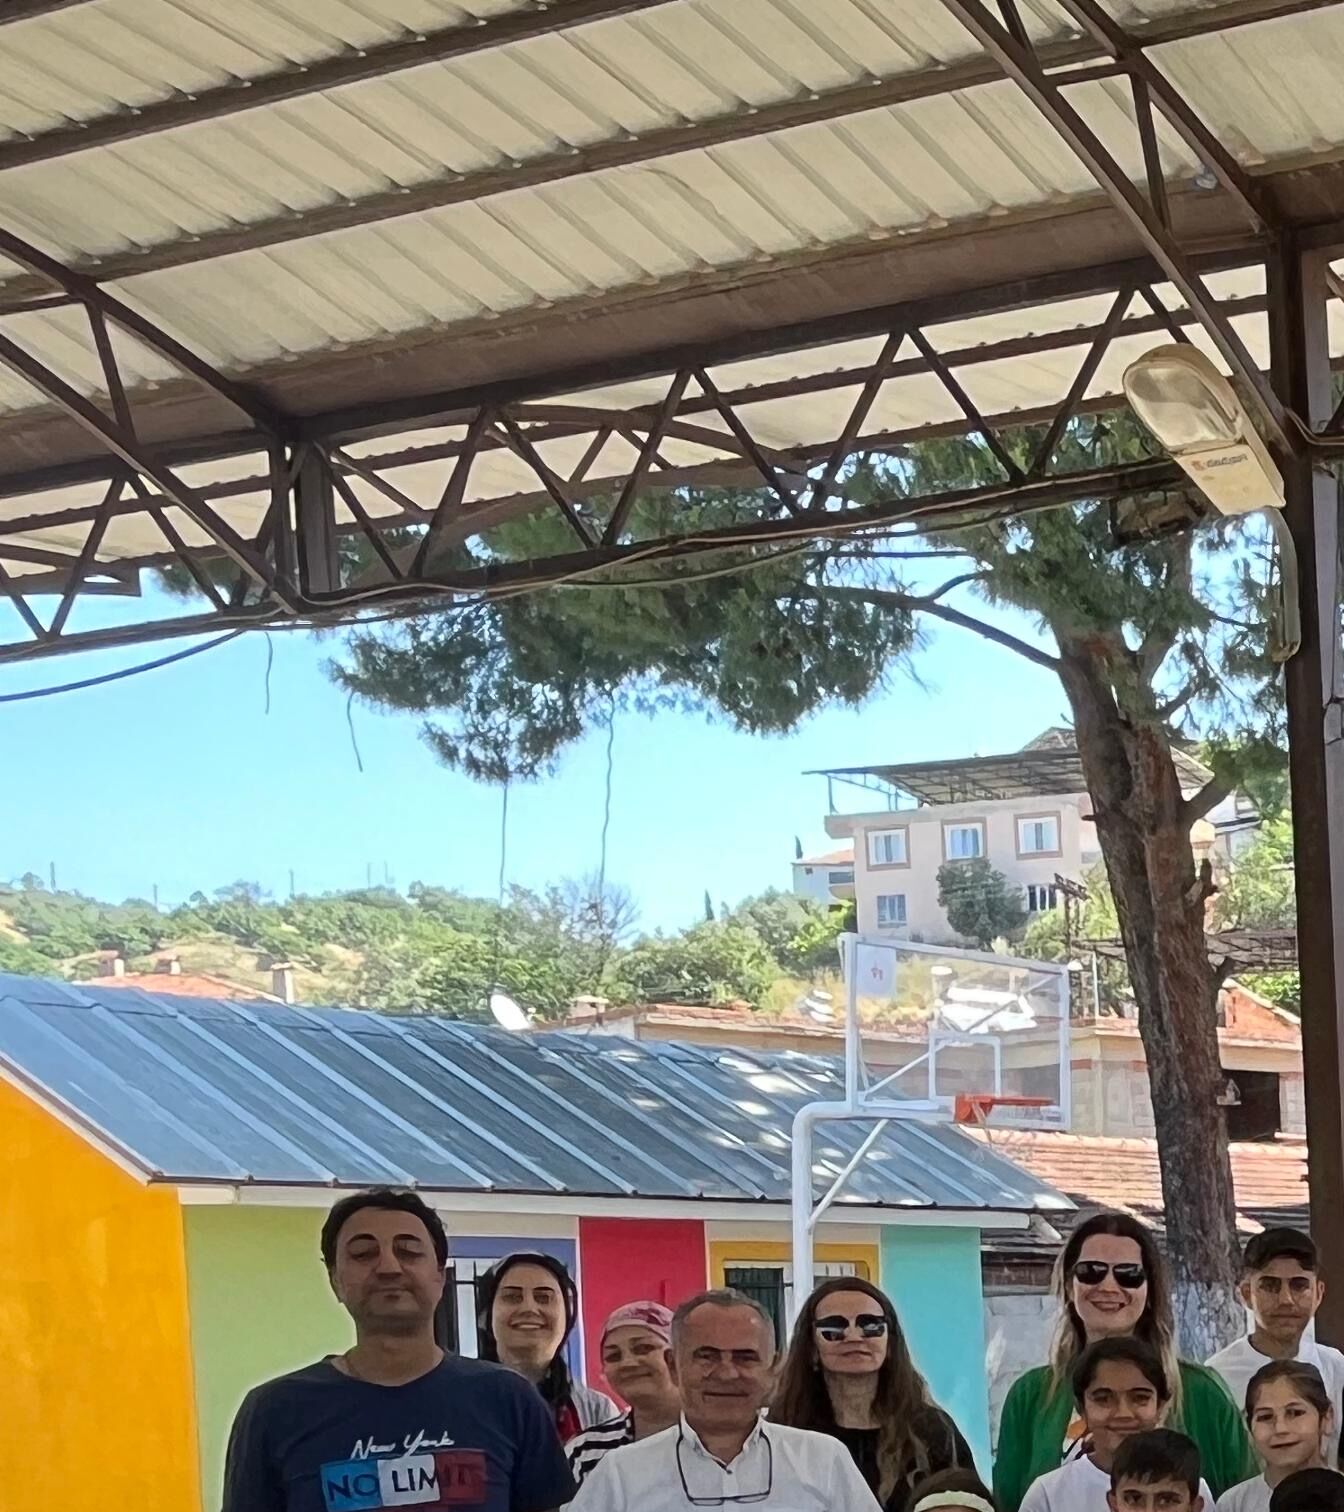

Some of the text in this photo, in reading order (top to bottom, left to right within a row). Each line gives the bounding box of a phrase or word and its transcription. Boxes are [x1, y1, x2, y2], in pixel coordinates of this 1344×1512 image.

[351, 1429, 456, 1460] New York
[327, 1474, 379, 1502] NO
